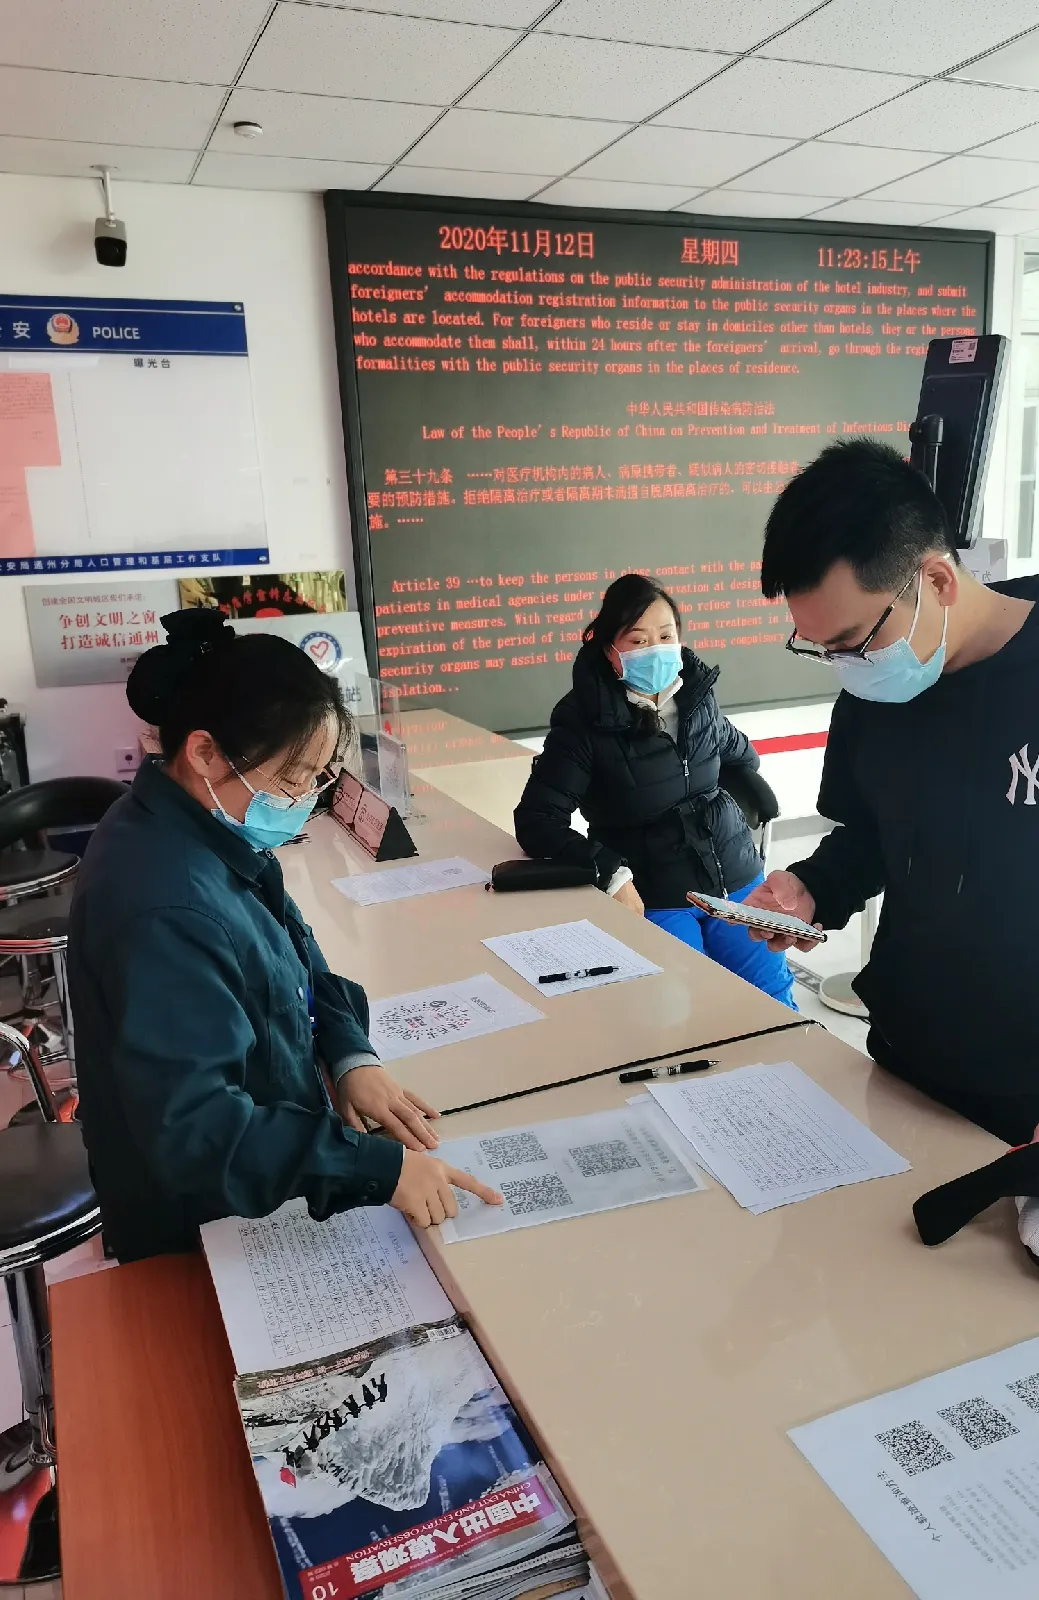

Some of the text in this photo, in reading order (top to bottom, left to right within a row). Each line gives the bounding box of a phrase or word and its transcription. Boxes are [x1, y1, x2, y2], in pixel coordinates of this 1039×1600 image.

[438, 225, 595, 258] 2020年11月12日
[680, 238, 740, 265] 星期四
[817, 247, 920, 272] 11:23:15上午
[347, 261, 967, 297] accordance with the regulations on the public security administration of the hotel industry, and submit
[443, 290, 534, 305] accommodation
[538, 294, 617, 308] registration
[621, 295, 690, 310] information
[694, 299, 707, 310] to
[711, 299, 730, 311] the
[733, 299, 768, 312] public
[773, 302, 819, 314] security
[823, 304, 857, 315] organs
[861, 304, 873, 314] in
[875, 303, 893, 315] the
[895, 305, 928, 316] places
[930, 305, 957, 316] where
[961, 306, 976, 317] the
[92, 326, 141, 340] POLICE
[351, 308, 976, 336] hotels are located. For foreigners who reside or stay in domiciles other than hotels, they or the persons
[352, 332, 377, 347] who
[383, 334, 461, 348] accommodate
[468, 335, 496, 350] them
[501, 335, 538, 351] shall,
[546, 337, 587, 352] within
[591, 338, 605, 351] 24
[610, 338, 642, 352] hours
[646, 339, 677, 352] after
[683, 340, 702, 352] the
[779, 343, 822, 356] arrival,
[828, 344, 840, 356] go
[845, 343, 882, 355] through
[886, 343, 901, 354] the
[133, 357, 171, 370] 曝光台
[355, 355, 800, 375] formalities with the public security organs in the places of residence.
[626, 401, 776, 416] 中华人民共和国传染病防治法
[421, 427, 445, 440] Law
[451, 425, 465, 439] of
[471, 425, 492, 440] the
[560, 424, 612, 439] Republic
[616, 424, 630, 437] of
[635, 423, 667, 438] China
[670, 426, 684, 436] on
[687, 423, 746, 436] Prevention
[750, 423, 768, 435] and
[773, 422, 821, 434] Treatment
[826, 423, 837, 434] of
[842, 423, 893, 433] Infectious
[384, 468, 453, 485] 第三十九条
[0, 552, 222, 572] 安局通州分局人口管理和基层工作支队
[391, 578, 439, 593] Article
[445, 576, 461, 589] 39
[497, 574, 525, 586] keep
[530, 572, 550, 584] the
[554, 571, 598, 583] persons
[604, 569, 617, 579] in
[654, 564, 695, 576] contact
[700, 561, 725, 573] with
[728, 560, 745, 572] the
[374, 600, 431, 617] patients
[437, 600, 450, 611] in
[455, 596, 501, 610] medical
[507, 593, 559, 608] agencies
[563, 589, 595, 603] under
[714, 581, 724, 592] at
[59, 609, 156, 629] 争创文明之窗
[376, 621, 445, 639] preventive
[450, 617, 508, 631] measures.
[514, 612, 541, 625] With
[546, 610, 584, 624] regard
[697, 598, 731, 611] refuse
[736, 595, 785, 608] treatment
[60, 630, 159, 650] 打造诚信通州
[378, 611, 779, 658] expiration of the period of isol from treatment in
[379, 663, 433, 678] security
[440, 660, 480, 673] organs
[485, 657, 504, 669] may
[510, 653, 548, 667] assist
[554, 651, 574, 662] the
[692, 636, 727, 650] taking
[730, 633, 786, 646] compulsory
[344, 1481, 531, 1563] CHINA EXIT AND ENTRY OBSERVATION
[350, 1491, 541, 1585] 中国出入境观察
[310, 1579, 340, 1600] 10
